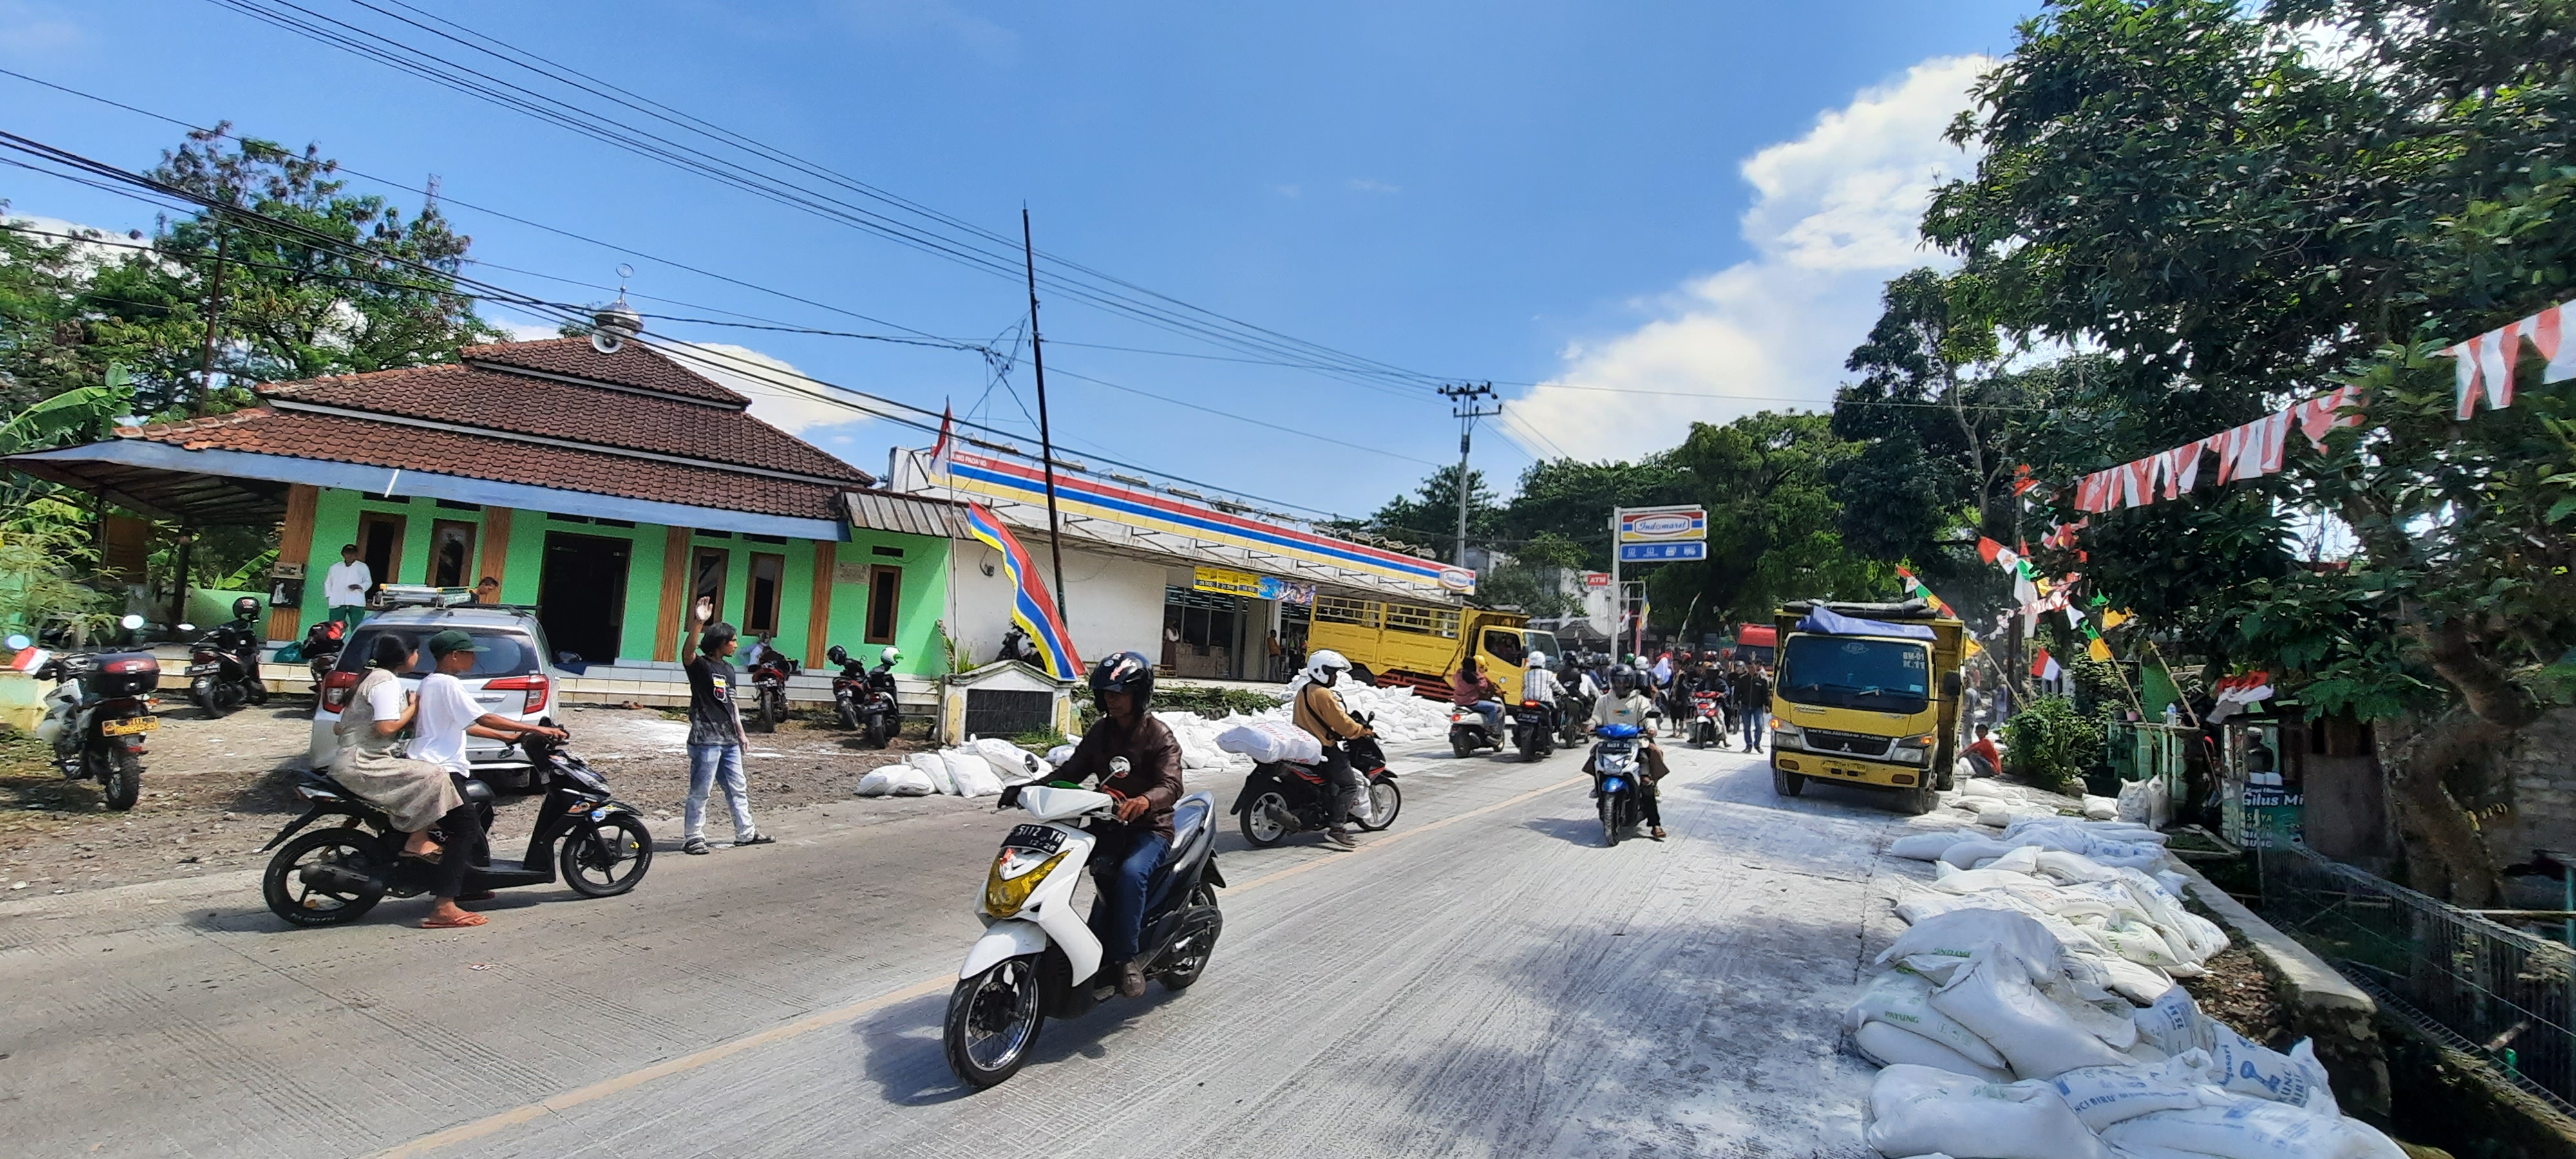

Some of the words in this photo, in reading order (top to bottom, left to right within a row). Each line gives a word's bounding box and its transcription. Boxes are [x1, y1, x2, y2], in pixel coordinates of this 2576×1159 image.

[1638, 521, 1686, 531] Indomaret
[1903, 652, 1924, 661] BM-01
[1808, 729, 1859, 738] MITSUBISHI
[2243, 792, 2279, 806] Gilus
[1049, 830, 1066, 843] YH
[1884, 1010, 1920, 1024] PAYUNG
[2092, 1095, 2116, 1106] BIRU
